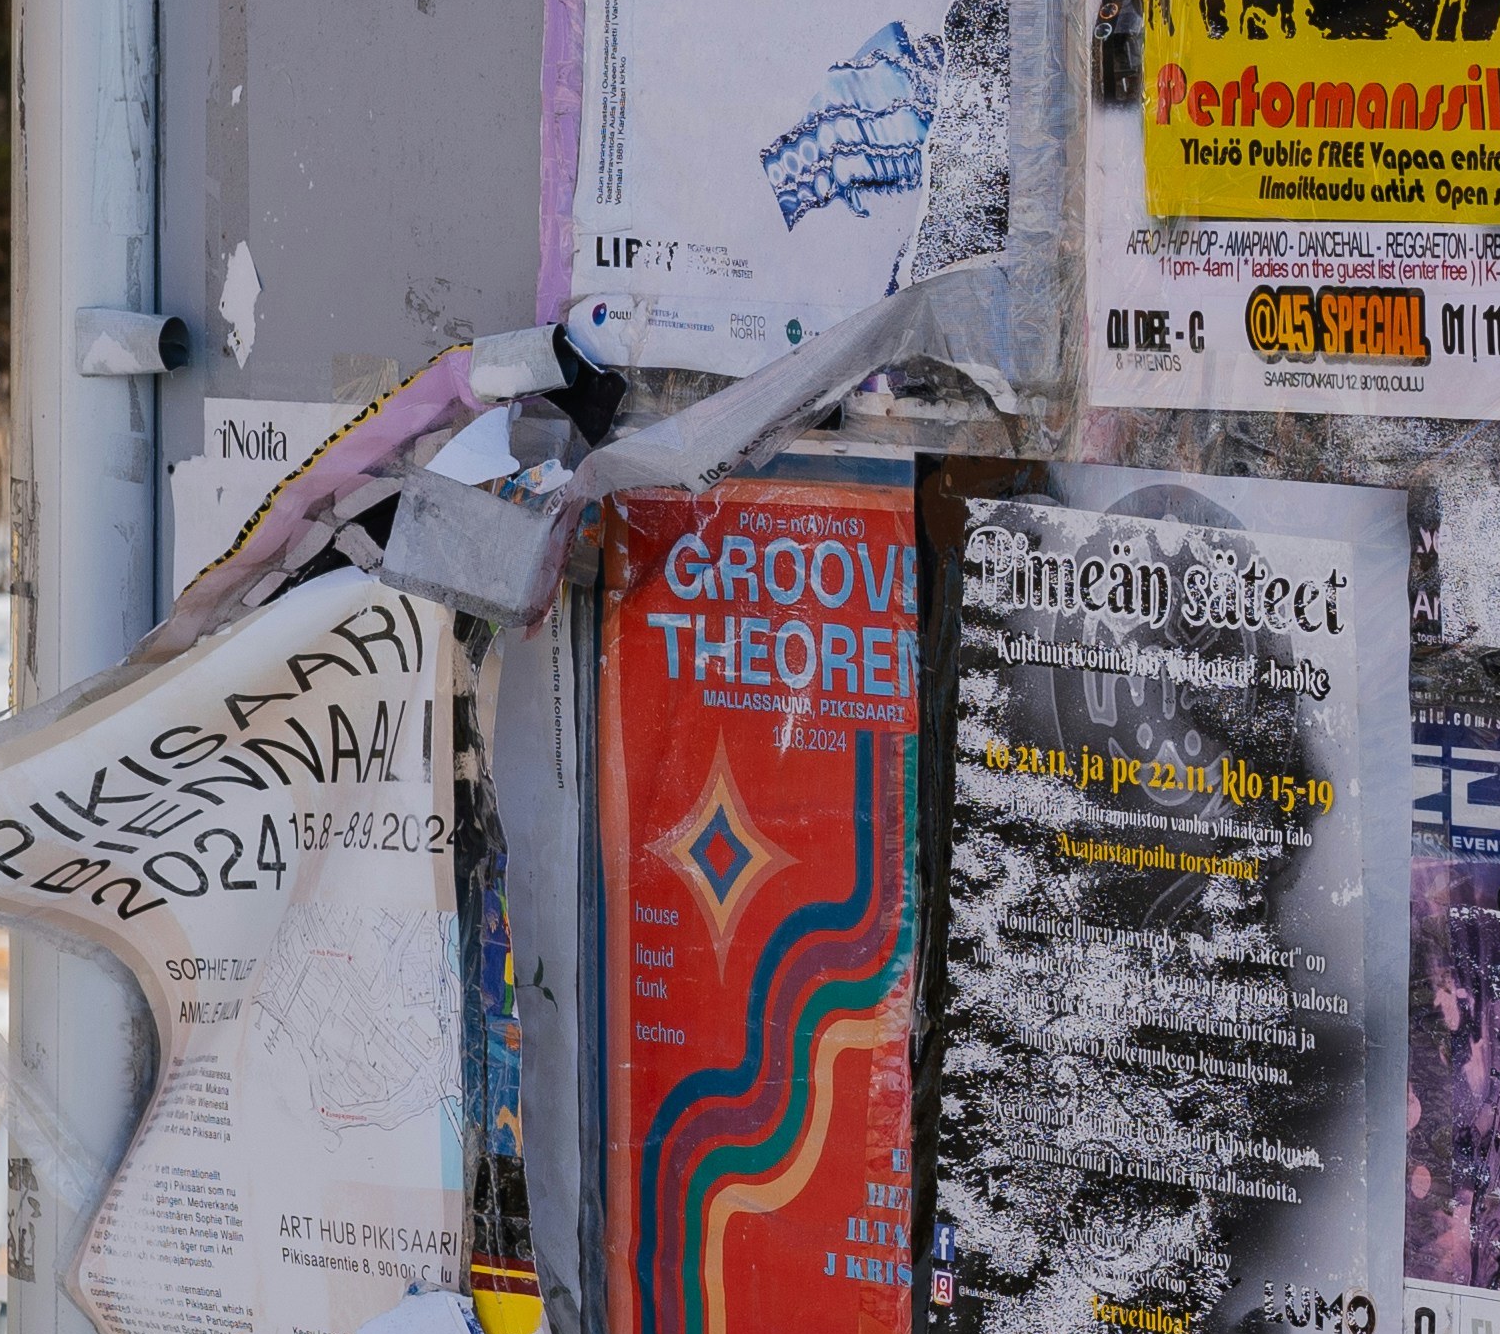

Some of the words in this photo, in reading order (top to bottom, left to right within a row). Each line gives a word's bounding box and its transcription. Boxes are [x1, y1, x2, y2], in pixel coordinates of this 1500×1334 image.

[1179, 138, 1243, 167] Yleisö
[1248, 138, 1313, 168] Public
[1317, 141, 1365, 168] FREE
[1370, 140, 1446, 175] Vapaa
[1258, 174, 1366, 204] Ilmoittaudu
[1370, 177, 1426, 205] artist
[1435, 179, 1489, 215] Open
[1298, 232, 1375, 258] DANCEHALL
[1385, 233, 1468, 260] REGGAETON
[1250, 258, 1284, 278] ladies
[1337, 261, 1376, 282] guest
[1134, 310, 1171, 353] DEE
[1320, 288, 1429, 362] SPECIAL
[966, 524, 1173, 631] Pimeän
[1181, 550, 1351, 638] säteet
[703, 689, 816, 717] MALLASSAUNA,
[1015, 744, 1074, 777] 21.11.
[1078, 743, 1105, 790] ja
[1111, 755, 1142, 794] pe
[1149, 765, 1214, 794] 22.11.
[1221, 757, 1263, 806] klo
[1270, 775, 1335, 815] 15-19
[1057, 831, 1176, 873] Avajaistarjoilu
[635, 901, 680, 927] house
[635, 942, 675, 970] liquid
[635, 977, 668, 1000] funk
[1293, 986, 1349, 1014] valosta
[635, 1020, 685, 1047] techno
[279, 1213, 313, 1240] ART
[319, 1218, 357, 1246] HUB
[362, 1224, 458, 1257] PIKISAARI
[281, 1247, 360, 1273] Pikisaarentie
